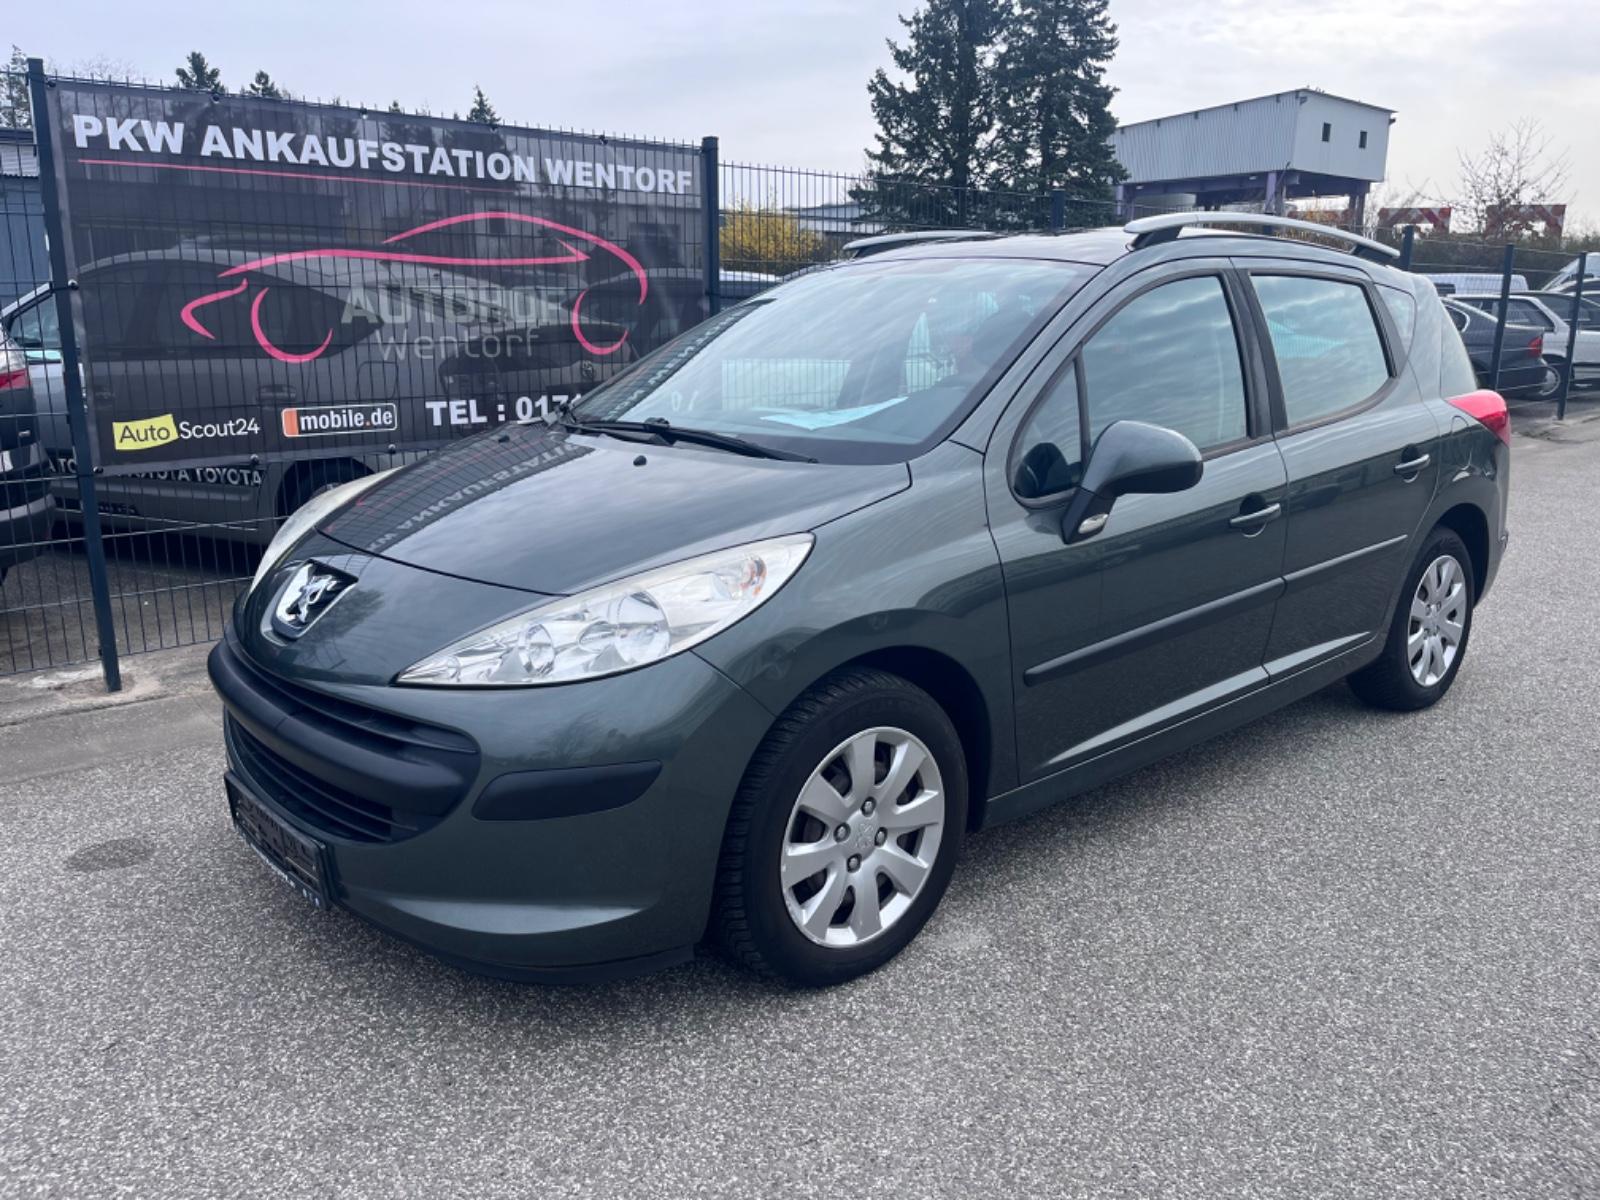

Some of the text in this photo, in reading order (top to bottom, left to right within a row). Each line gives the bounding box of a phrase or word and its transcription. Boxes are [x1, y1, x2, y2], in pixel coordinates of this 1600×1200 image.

[73, 113, 692, 195] PKW ANKAUFSTATION WENTORF
[300, 407, 393, 431] mobile.de
[425, 399, 488, 426] TEL
[120, 417, 260, 443] Auto Scout24
[195, 467, 262, 487] TOYOTA
